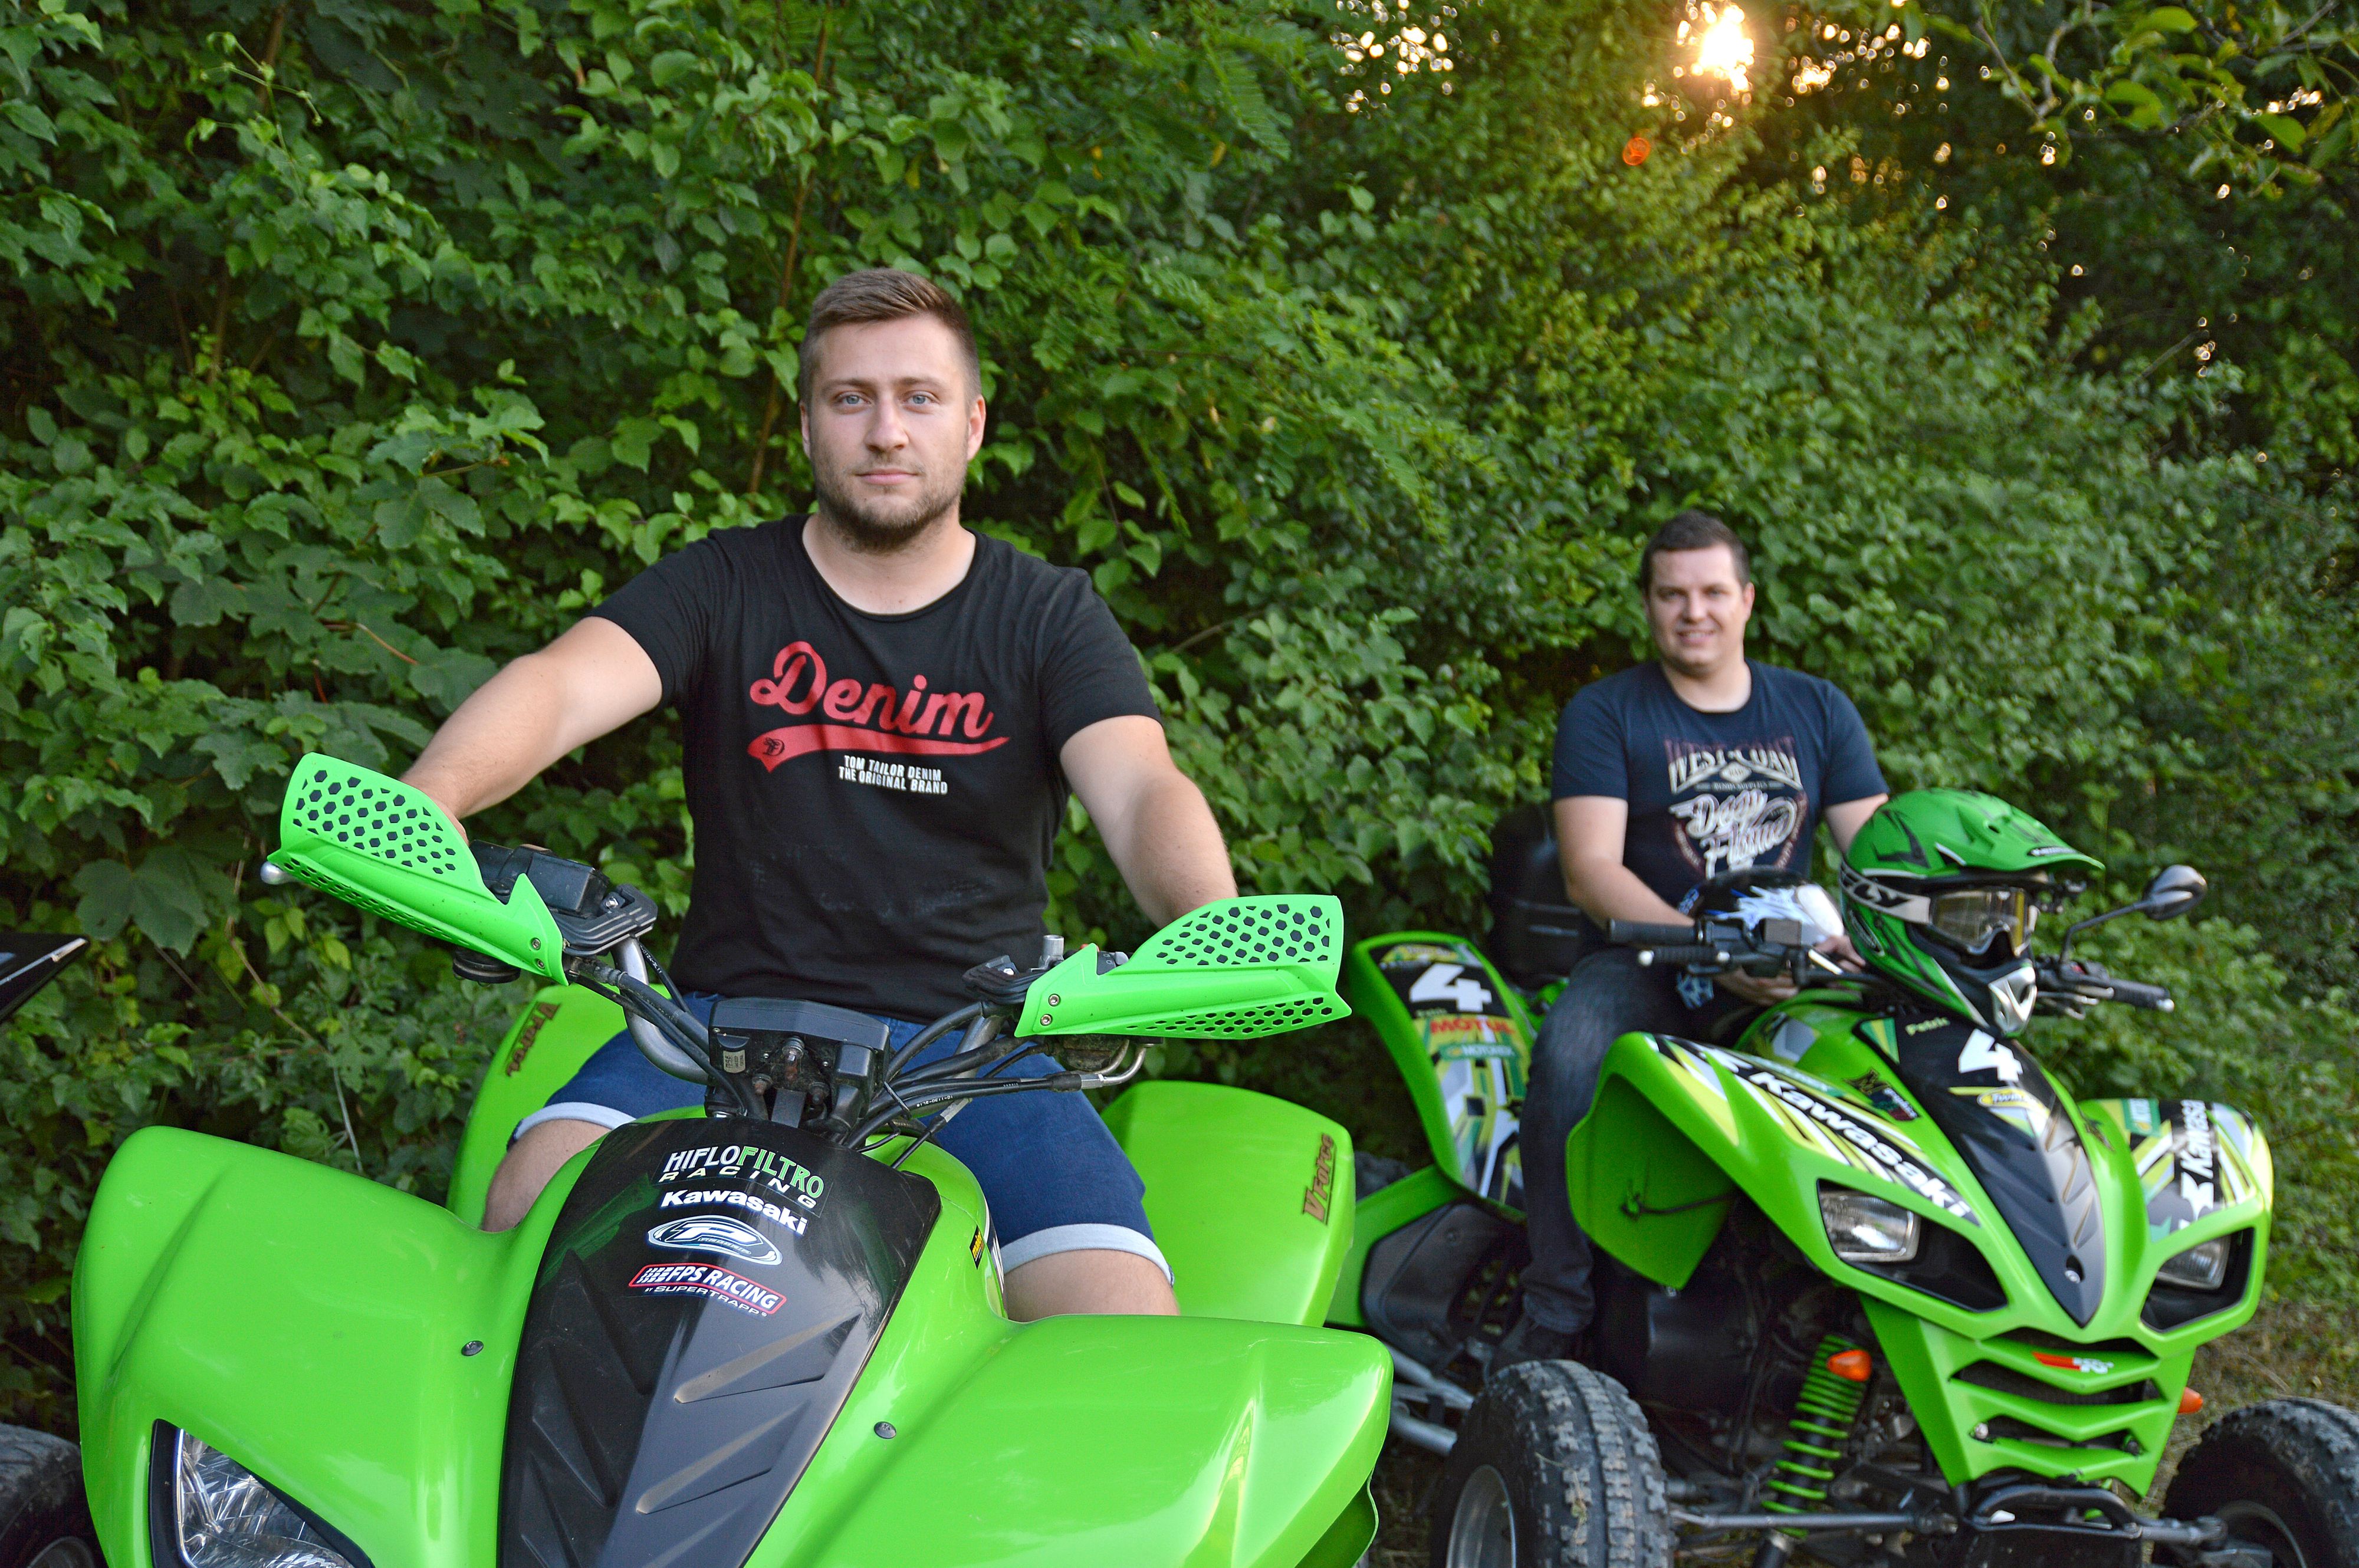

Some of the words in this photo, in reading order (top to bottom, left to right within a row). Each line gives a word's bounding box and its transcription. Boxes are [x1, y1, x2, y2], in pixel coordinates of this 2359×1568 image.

[750, 641, 994, 738] Denim
[839, 766, 857, 781] THE
[859, 770, 906, 791] ORIGINAL
[911, 779, 948, 795] BRAND
[844, 755, 865, 770] TOM
[869, 760, 905, 778] TAILOR
[908, 765, 942, 782] DENIM
[1409, 962, 1492, 1013] 4
[1430, 1018, 1516, 1036] MOTUL
[1958, 1028, 2023, 1082] 4
[1748, 1071, 1972, 1218] Kawasaki
[659, 1165, 817, 1209] RACING
[660, 1189, 808, 1235] Kawasaki
[653, 1286, 760, 1315] SUPERTRAPP
[665, 1266, 708, 1282] FPS
[702, 1269, 779, 1309] RACING
